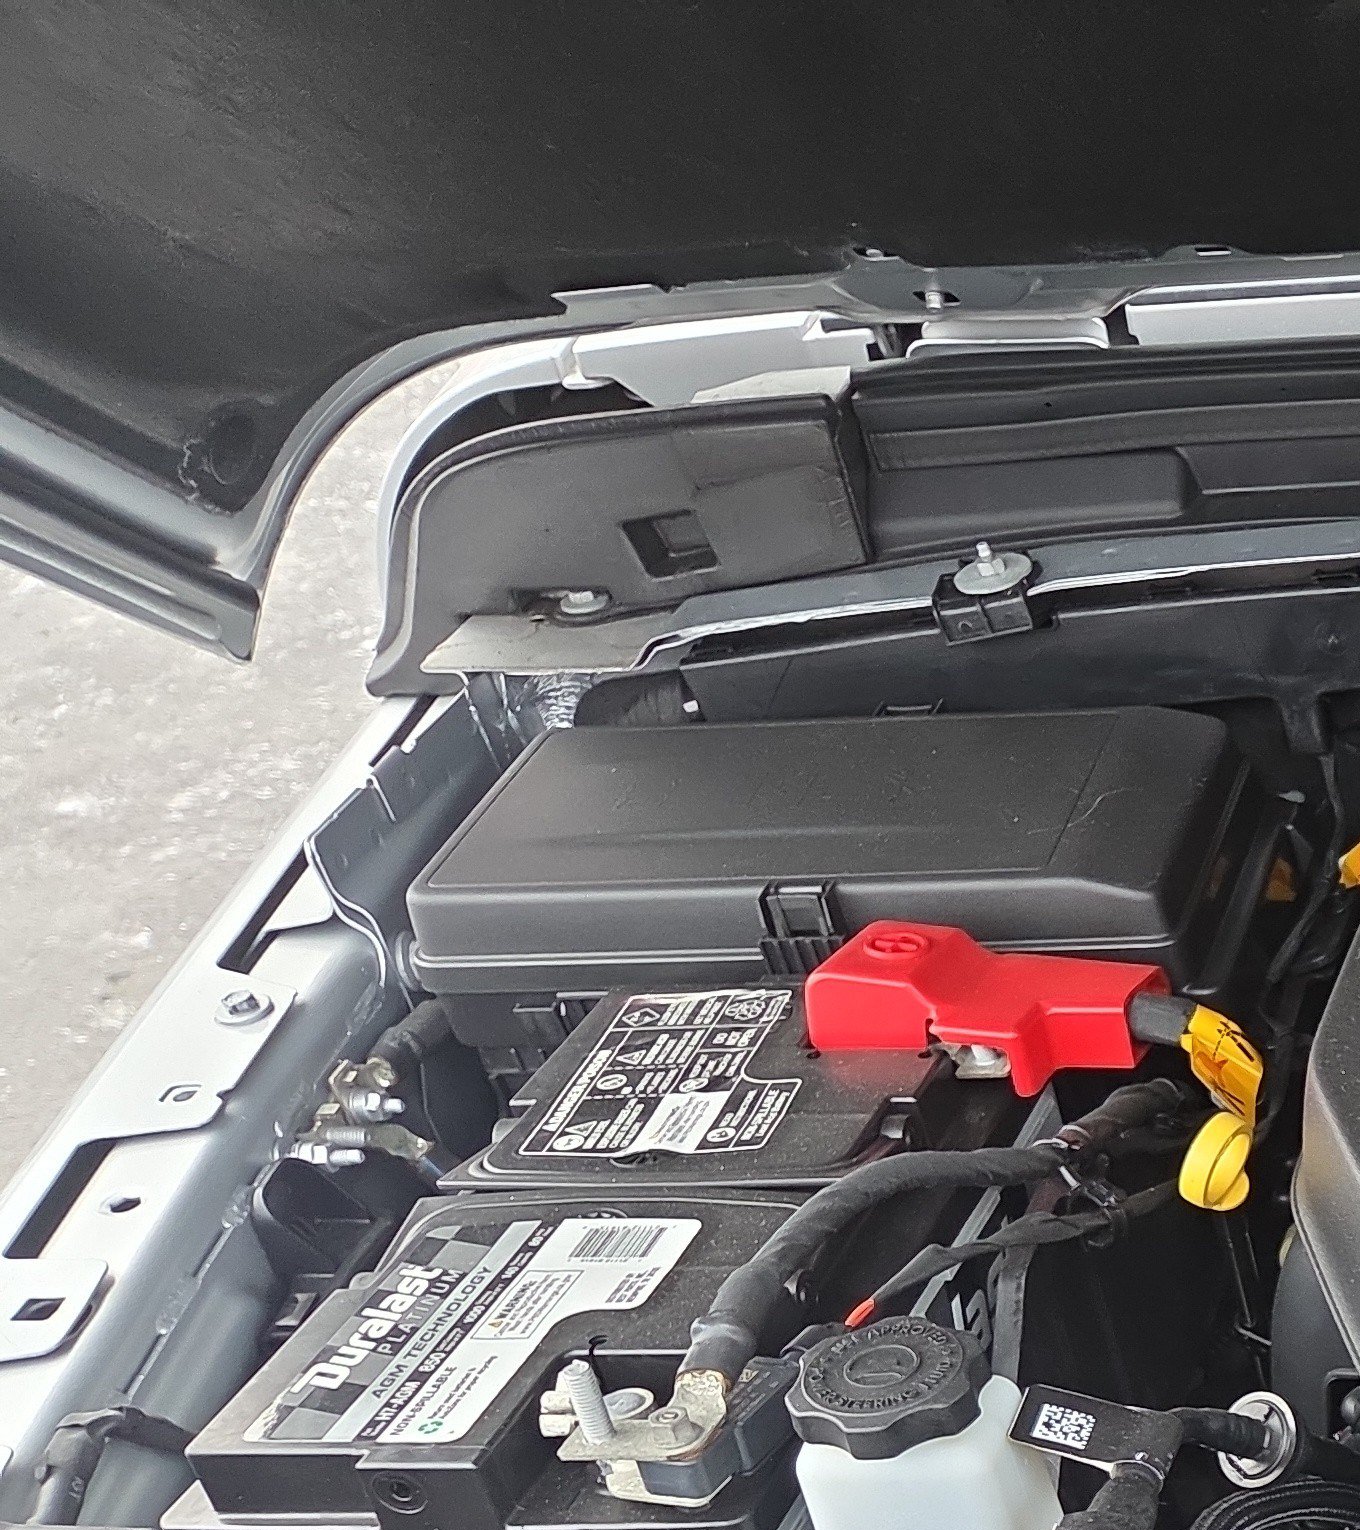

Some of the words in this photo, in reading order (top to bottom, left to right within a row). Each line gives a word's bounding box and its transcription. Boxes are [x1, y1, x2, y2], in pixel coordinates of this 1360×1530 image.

[290, 1264, 443, 1394] Duralast
[371, 1364, 409, 1400] AGM
[402, 1266, 492, 1360] TECHNOLOGY
[377, 1269, 464, 1355] PLATINUM
[495, 1281, 538, 1320] WARNING
[867, 1321, 947, 1344] APPROVED
[374, 1381, 421, 1421] H7-AGM
[418, 1352, 446, 1374] 850
[463, 1305, 486, 1324] 1000
[390, 1366, 458, 1436] NON-SPILLABLE
